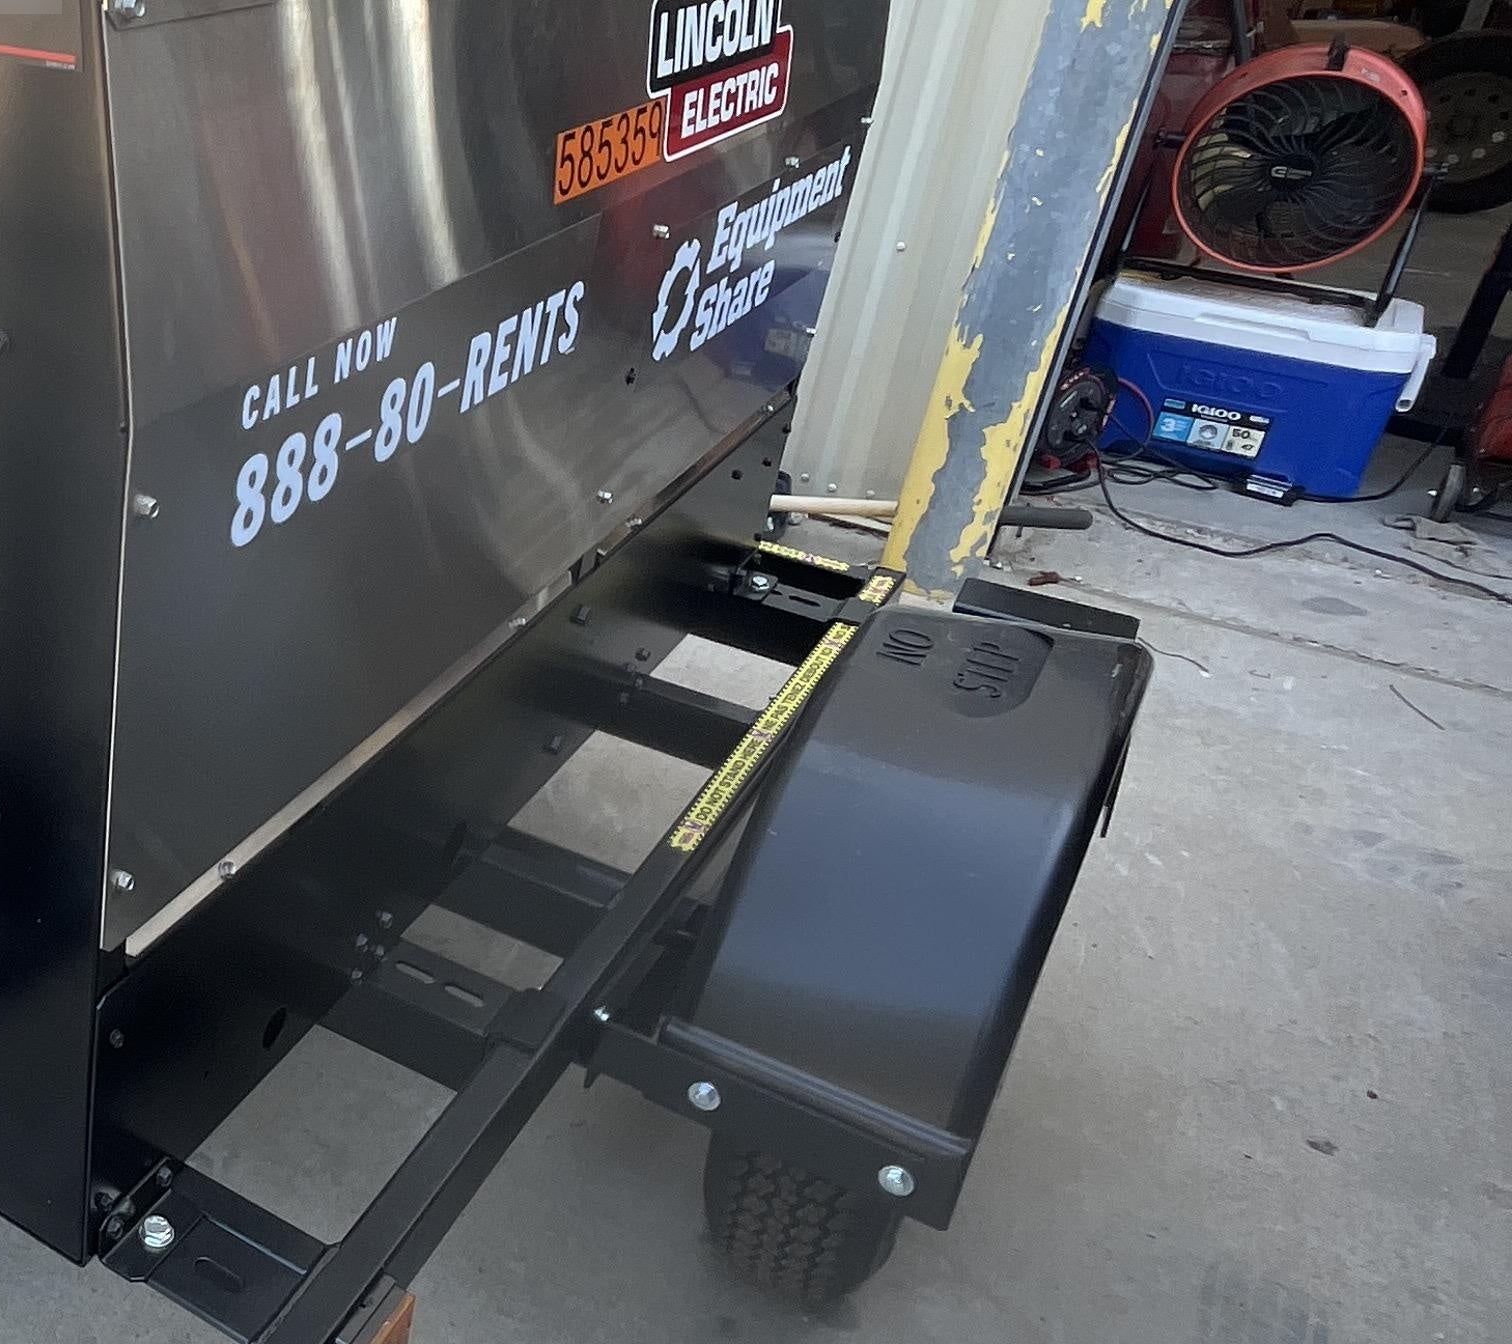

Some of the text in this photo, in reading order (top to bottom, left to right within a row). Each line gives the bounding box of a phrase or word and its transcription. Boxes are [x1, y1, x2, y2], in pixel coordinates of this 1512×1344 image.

[680, 62, 780, 139] ELECTRIC
[558, 100, 665, 196] 585359
[705, 145, 852, 274] Equipment
[690, 259, 775, 352] Share
[230, 280, 585, 547] 888-80-RENTS
[241, 317, 398, 430] CALL NOW
[875, 628, 935, 667] NO
[694, 737, 762, 819] DO NOT STAND HERE
